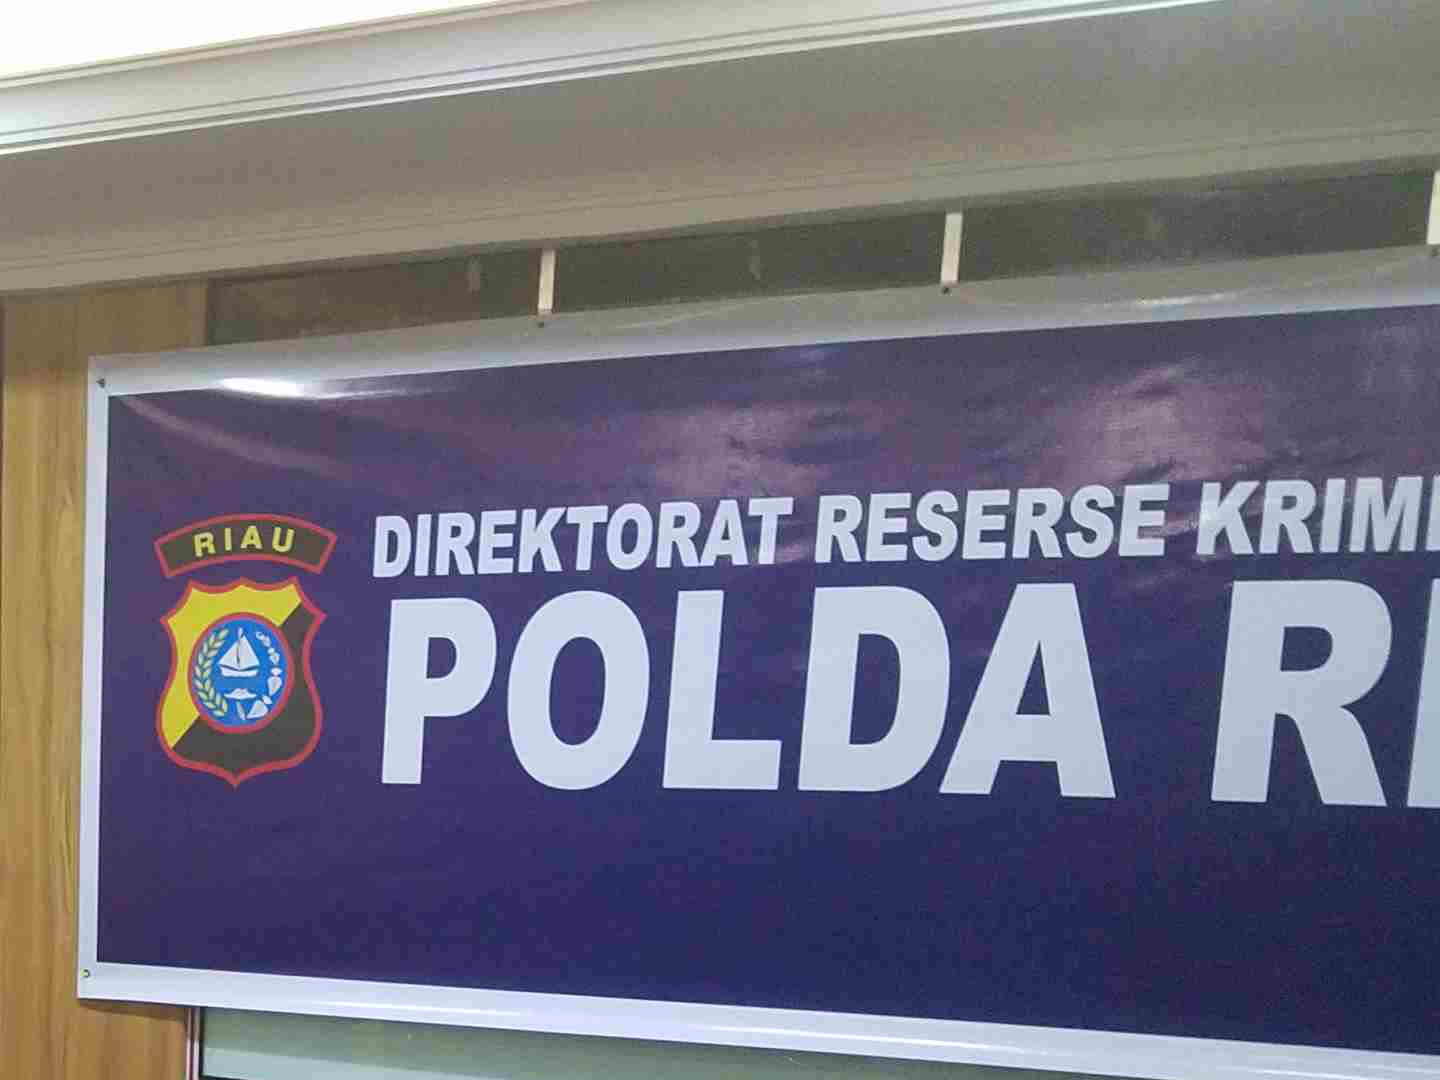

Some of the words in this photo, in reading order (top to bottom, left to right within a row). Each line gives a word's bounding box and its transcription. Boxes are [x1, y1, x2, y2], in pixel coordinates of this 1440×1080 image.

[193, 525, 295, 558] RIAU
[373, 497, 794, 577] DIREKTORAT
[814, 484, 1169, 562] RESERSE
[382, 583, 1116, 798] POLDA
